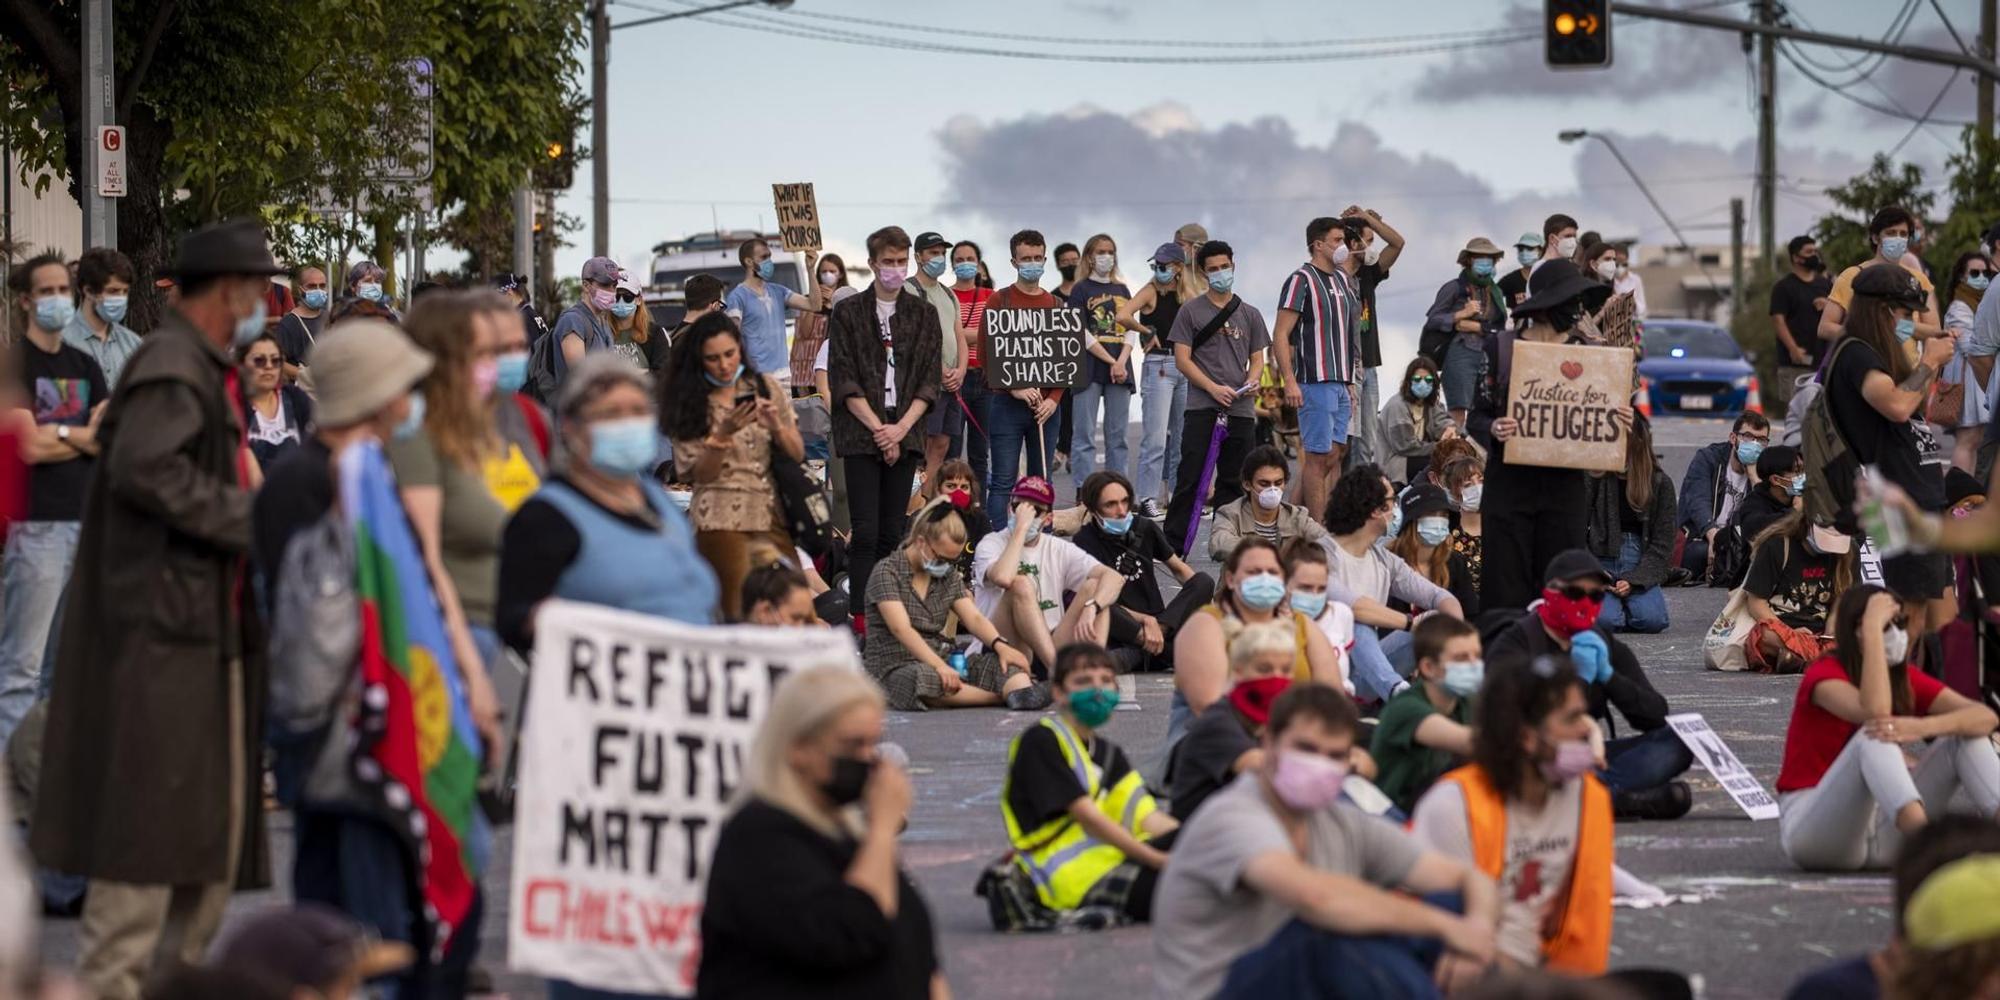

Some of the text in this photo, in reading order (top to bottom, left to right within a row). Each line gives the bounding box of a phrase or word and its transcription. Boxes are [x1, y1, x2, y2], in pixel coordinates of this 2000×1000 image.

[107, 131, 117, 149] C
[104, 177, 122, 185] TIMES
[774, 184, 811, 202] WHAT IF
[780, 204, 813, 223] IT WAS
[780, 225, 808, 248] YOUR
[986, 308, 1082, 335] BOUNDLESS
[994, 336, 1054, 358] PLAINS
[1057, 337, 1081, 357] TO
[1001, 361, 1077, 386] SHARE?
[1520, 378, 1610, 406] Justice for
[1511, 401, 1620, 443] REFUGEES
[594, 726, 744, 804] FUTU
[560, 803, 708, 882] MATT
